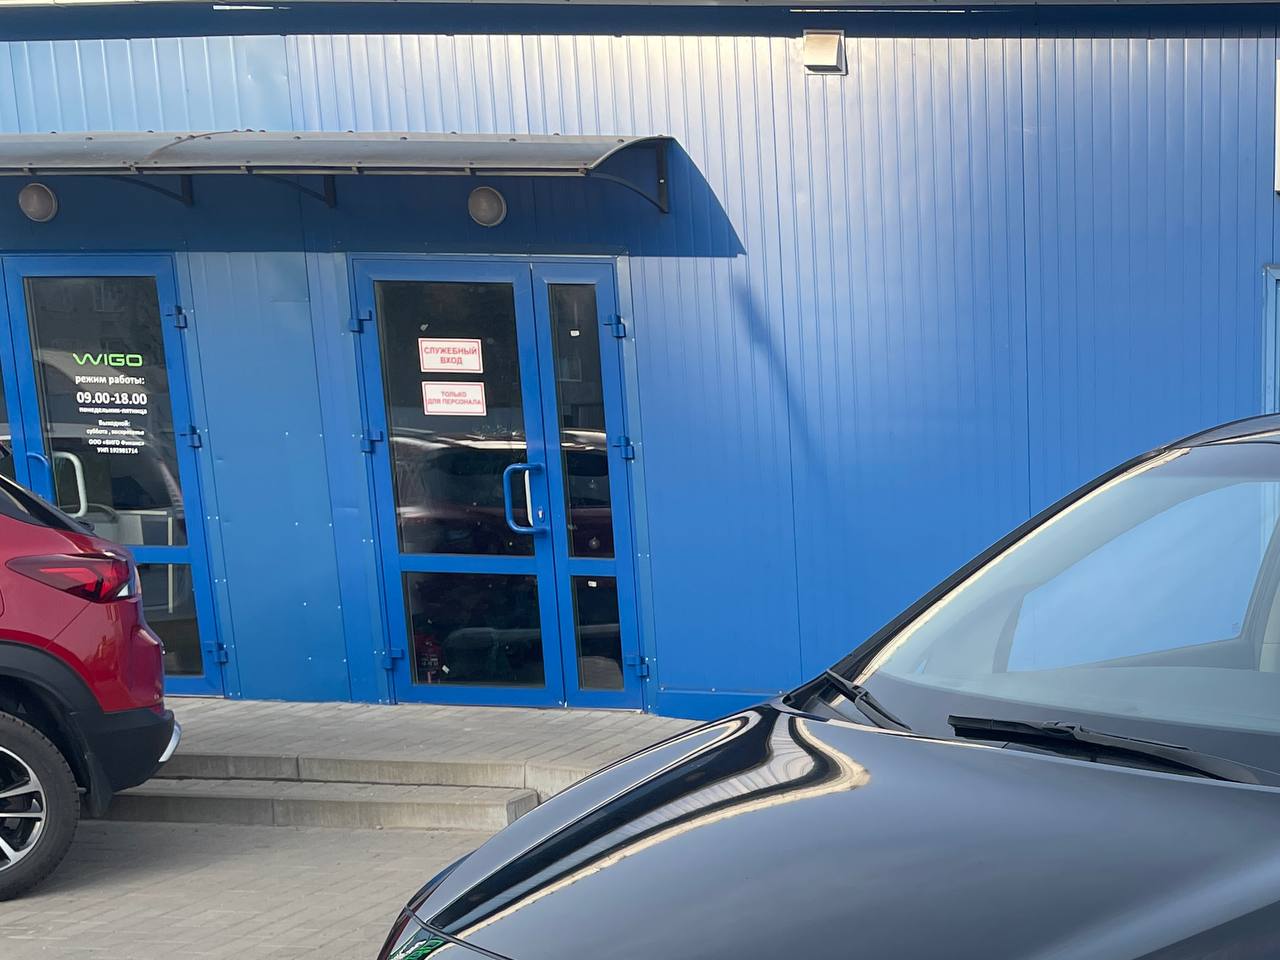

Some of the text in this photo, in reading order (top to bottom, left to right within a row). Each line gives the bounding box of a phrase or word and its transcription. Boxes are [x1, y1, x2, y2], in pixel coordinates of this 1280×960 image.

[424, 346, 477, 355] СЛУЖЕБНЫЙ
[72, 353, 143, 367] WIGO
[440, 356, 463, 365] ВХОД
[75, 374, 145, 386] режим работы:
[76, 391, 148, 405] 09.00-18.00
[442, 398, 481, 406] ПЕРСОНАЛА
